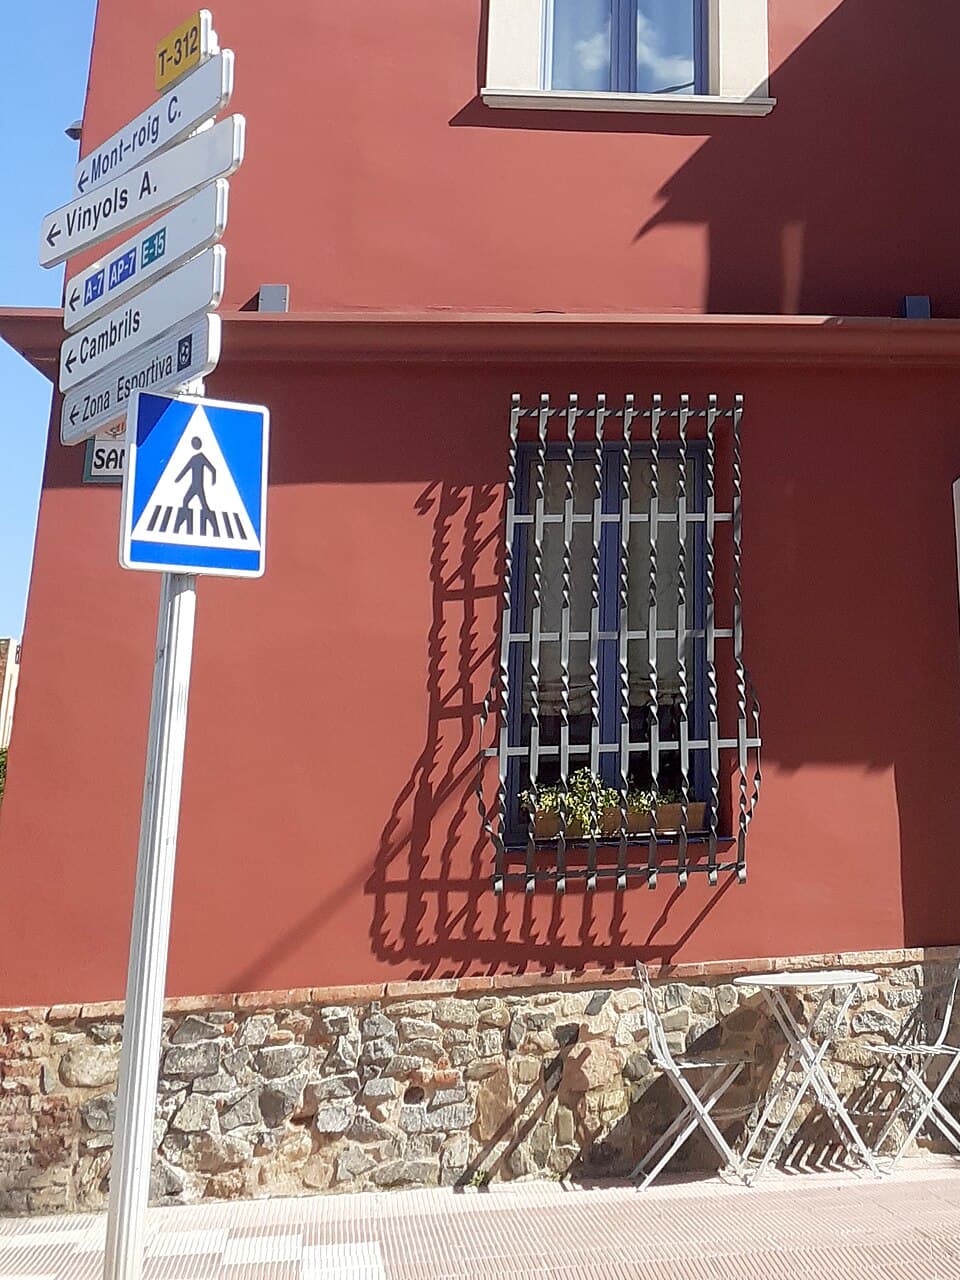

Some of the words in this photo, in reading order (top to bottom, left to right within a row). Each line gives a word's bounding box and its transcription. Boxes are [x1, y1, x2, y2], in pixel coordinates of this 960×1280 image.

[158, 25, 198, 76] T-312
[90, 114, 160, 183] Mont-roig
[167, 95, 182, 123] C.
[66, 187, 128, 237] Vinyols
[138, 170, 157, 200] A.
[85, 271, 104, 303] A-7
[110, 250, 136, 290] AP-7
[142, 231, 165, 266] E-15
[79, 308, 141, 364] Cambrils
[82, 390, 110, 422] Zona
